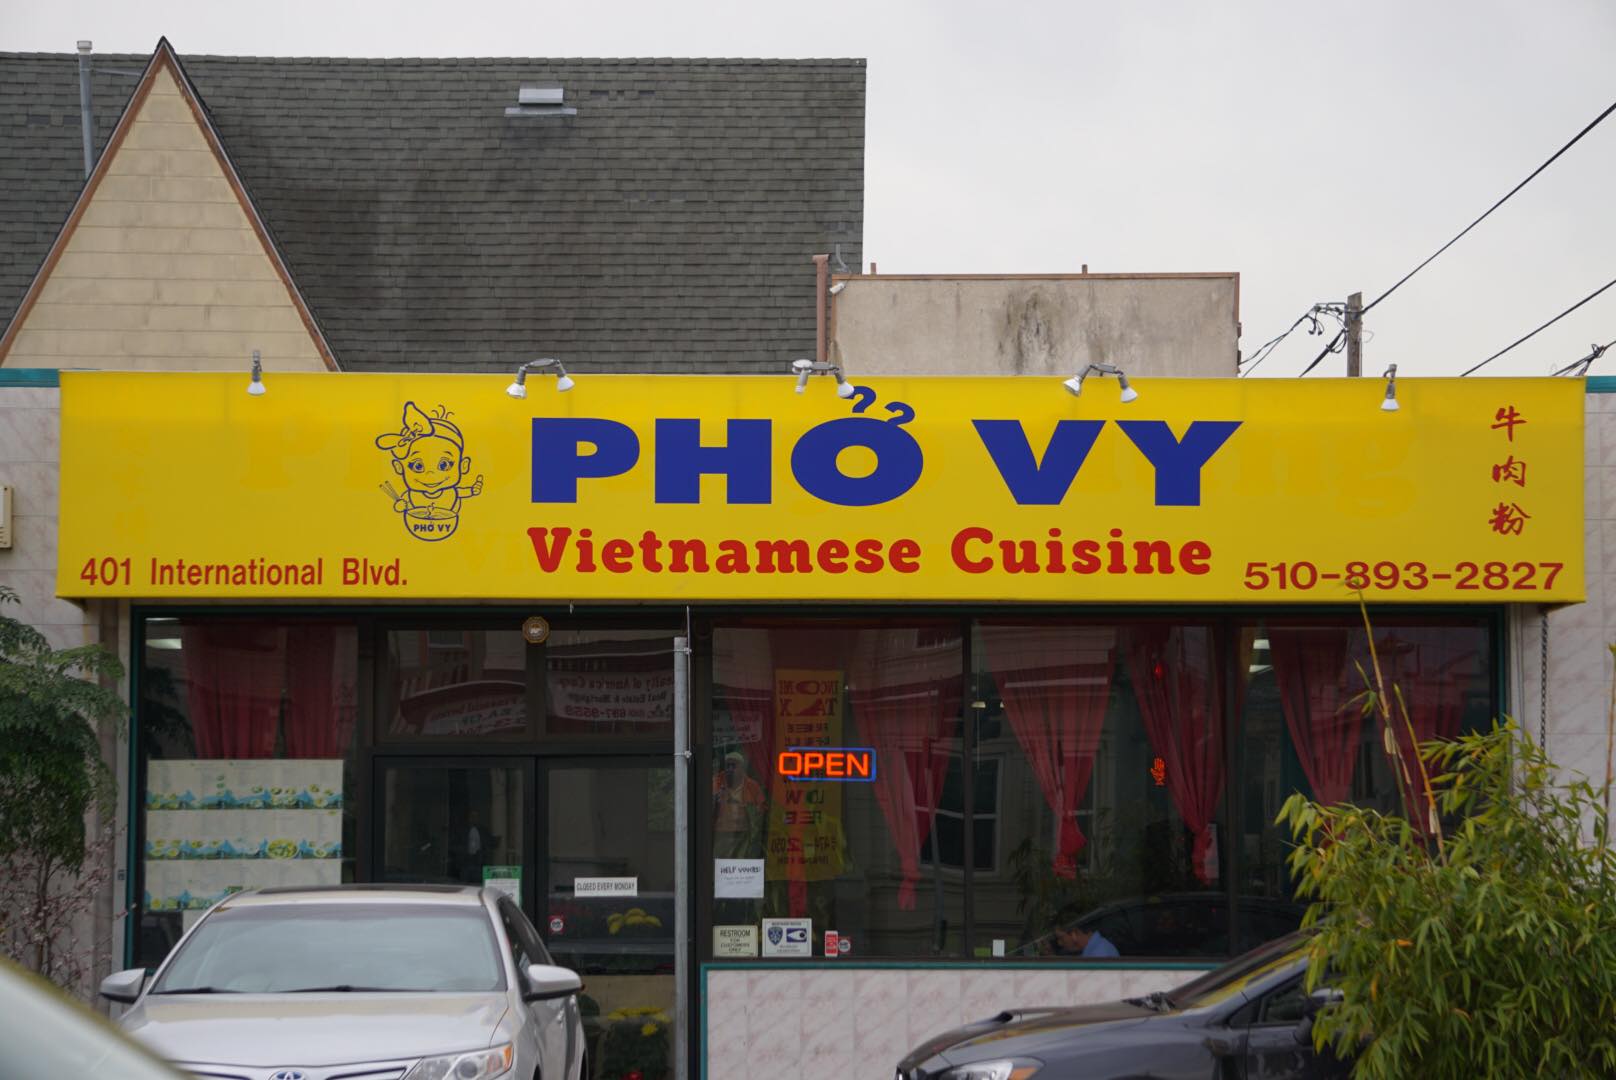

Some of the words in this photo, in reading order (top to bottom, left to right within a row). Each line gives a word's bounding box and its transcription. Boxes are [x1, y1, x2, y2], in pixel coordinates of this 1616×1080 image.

[971, 419, 1245, 506] VY
[1488, 405, 1531, 536] 牛肉粉
[438, 524, 451, 532] VY
[527, 527, 921, 575] Vietnamese
[951, 527, 1212, 575] Cuisine
[80, 557, 132, 586] 401
[151, 557, 323, 586] International
[343, 557, 407, 586] Blvd.
[1243, 561, 1564, 591] 510-893-2827
[779, 752, 869, 777] OPEN
[576, 882, 595, 892] CLOSED
[596, 881, 614, 891] EVERY
[615, 881, 635, 890] MONDAY
[719, 929, 751, 938] RESTROOM
